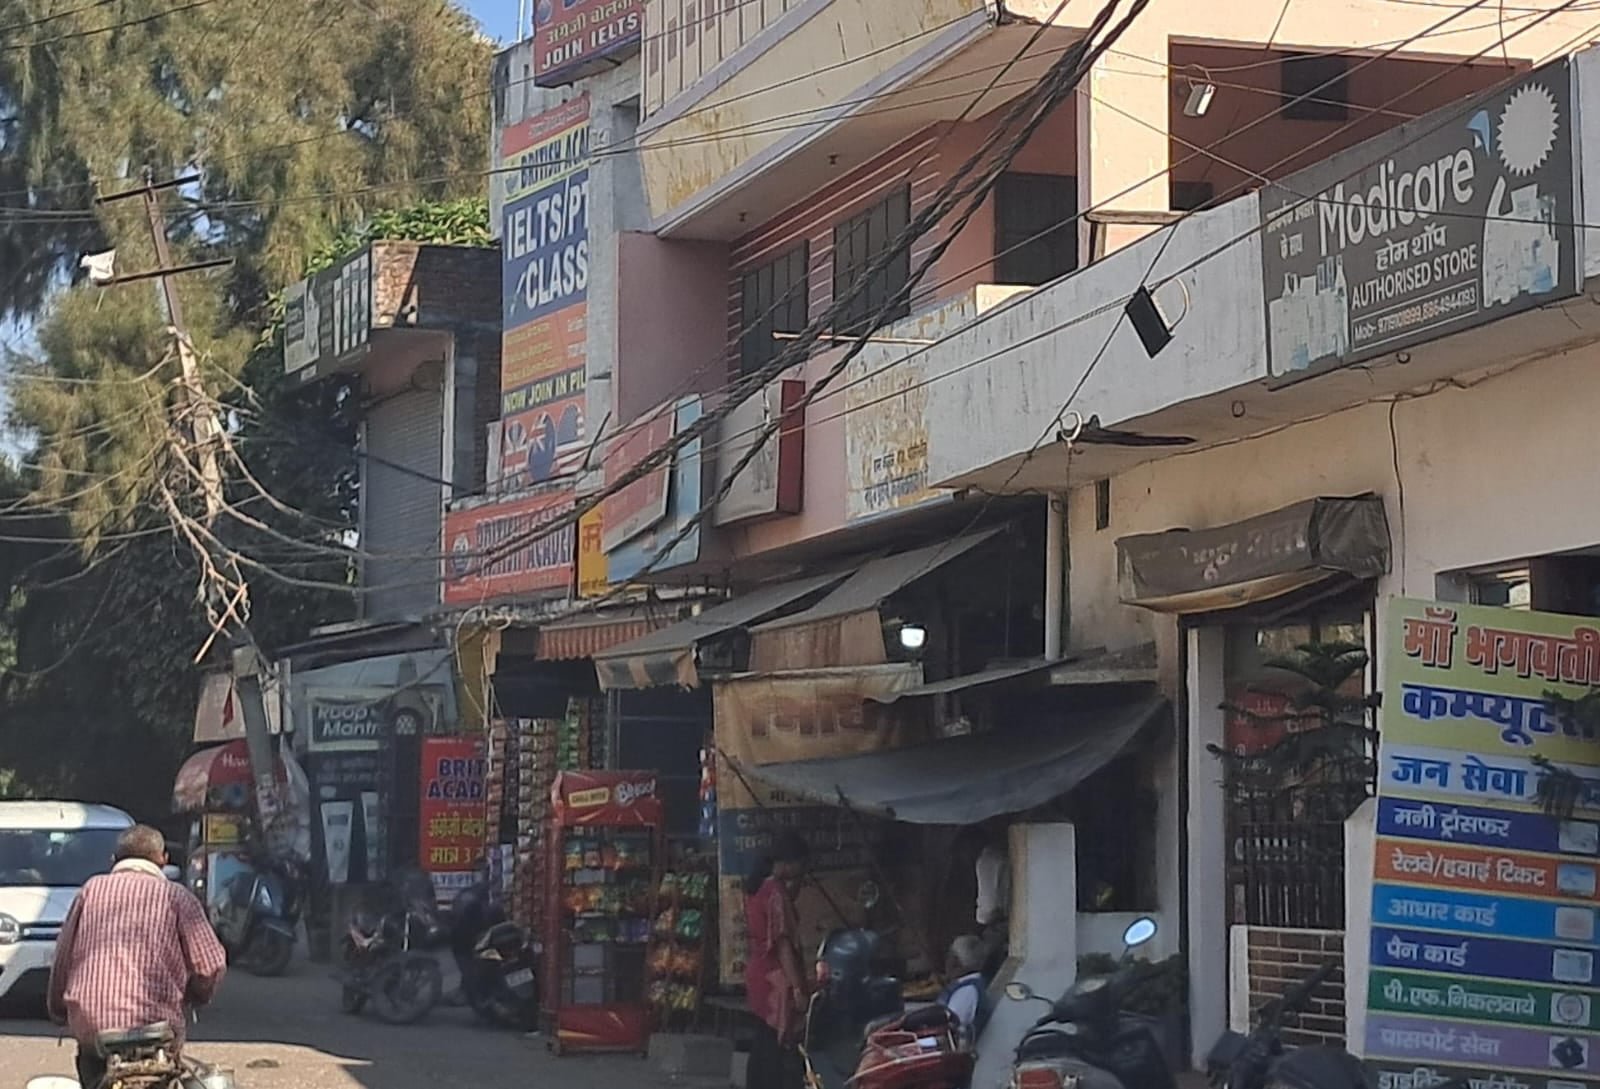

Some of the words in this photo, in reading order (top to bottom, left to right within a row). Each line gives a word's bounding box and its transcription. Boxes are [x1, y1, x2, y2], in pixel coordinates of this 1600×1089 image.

[542, 38, 583, 70] JOIN
[591, 12, 638, 48] IELTS
[1317, 149, 1476, 256] Modicare
[1376, 239, 1409, 271] होम
[1412, 222, 1447, 256] शॉप
[526, 239, 589, 310] CLASS
[1352, 262, 1431, 311] AUTHORISED
[1434, 244, 1477, 281] STORE
[504, 387, 526, 414] NOW
[529, 382, 552, 405] JOIN
[556, 375, 567, 396] IN
[1466, 625, 1600, 686] भगवती
[1391, 755, 1451, 787] जन
[1461, 755, 1528, 796] सेवा
[1394, 804, 1435, 829] मनी
[1440, 808, 1512, 839] ट्रांसफर
[1392, 848, 1492, 883] रेलवे/हवाई
[1496, 859, 1548, 886] टिकट
[1388, 898, 1448, 921] आधार
[1454, 902, 1497, 927] कार्ड
[1386, 935, 1417, 961] पैन
[1424, 942, 1469, 968] कार्ड
[1380, 1027, 1457, 1053] पासपोर्ट
[1460, 1031, 1500, 1056] सेवा
